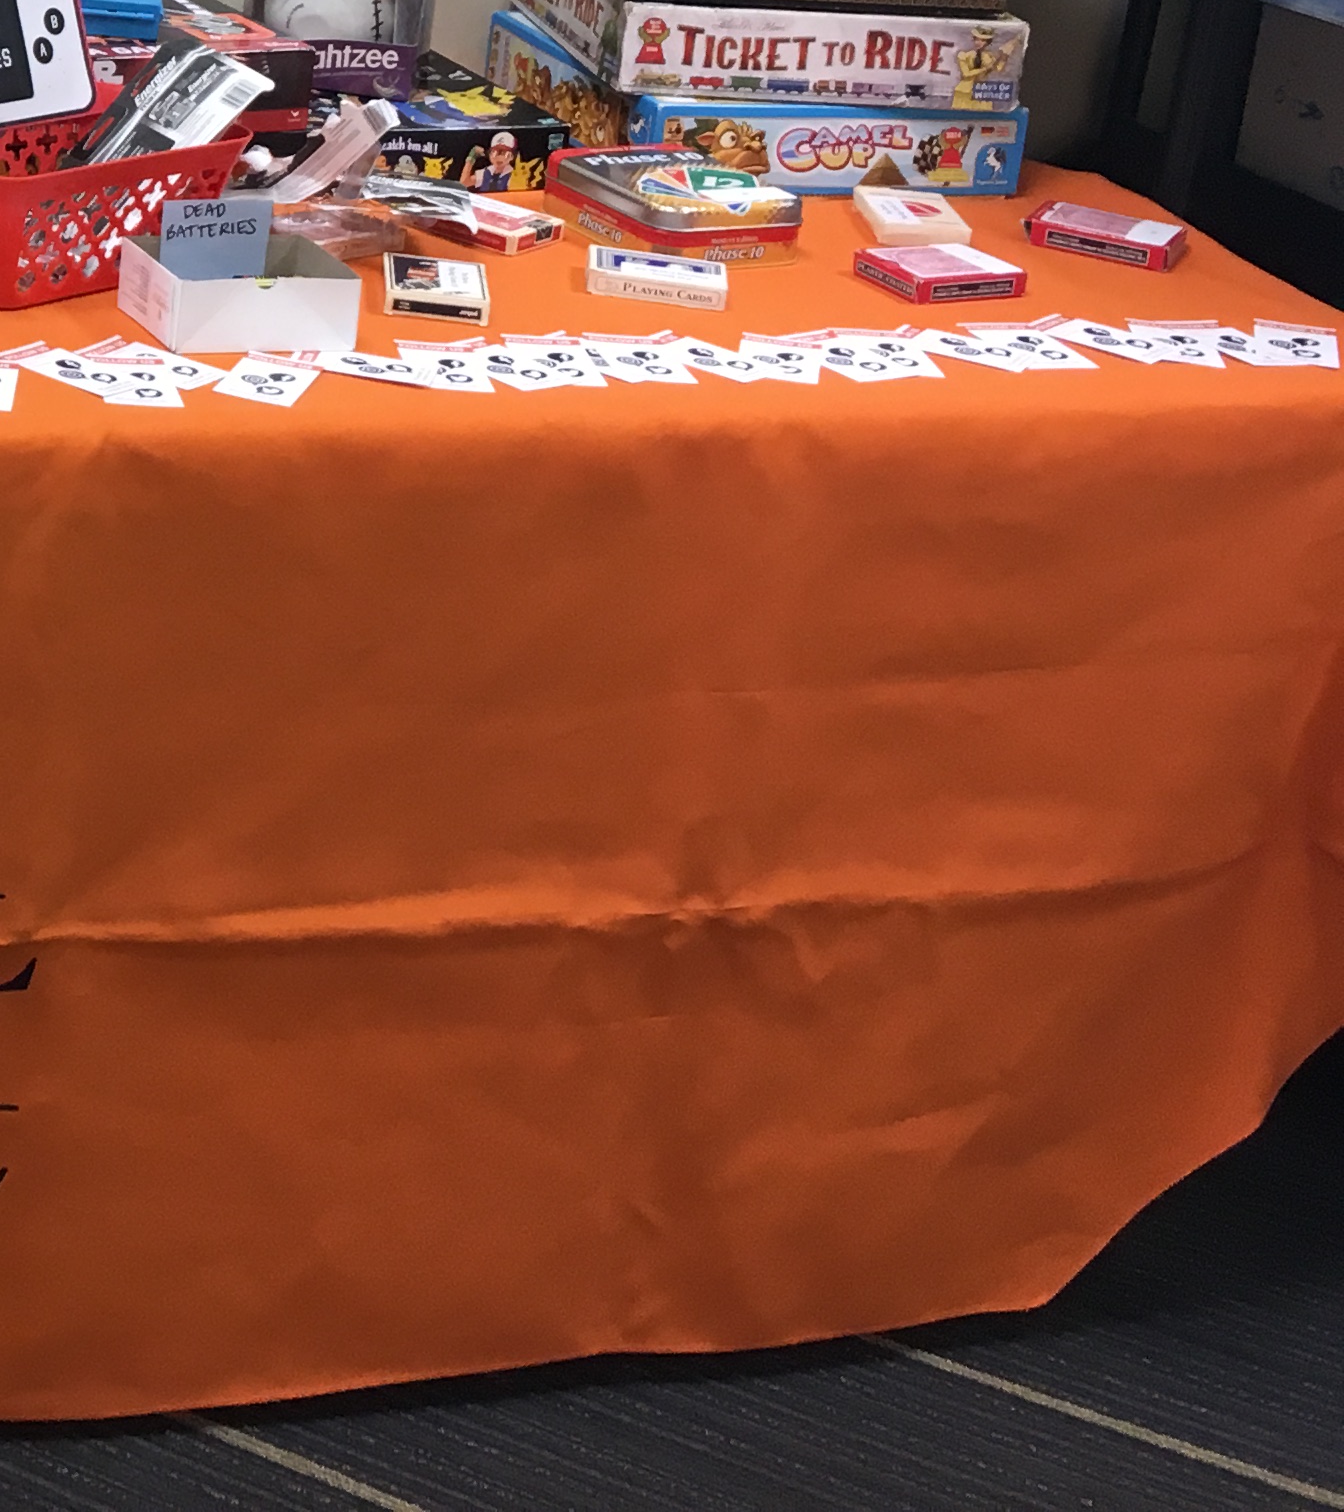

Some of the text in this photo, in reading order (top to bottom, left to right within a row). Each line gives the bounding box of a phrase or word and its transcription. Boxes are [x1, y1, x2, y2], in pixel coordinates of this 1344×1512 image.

[50, 14, 59, 29] B
[38, 42, 49, 58] A
[676, 25, 956, 75] TICKET TO RIDE
[183, 202, 228, 220] DEAD
[165, 218, 258, 241] BATTERIES
[622, 282, 713, 304] PLAYING CARDS
